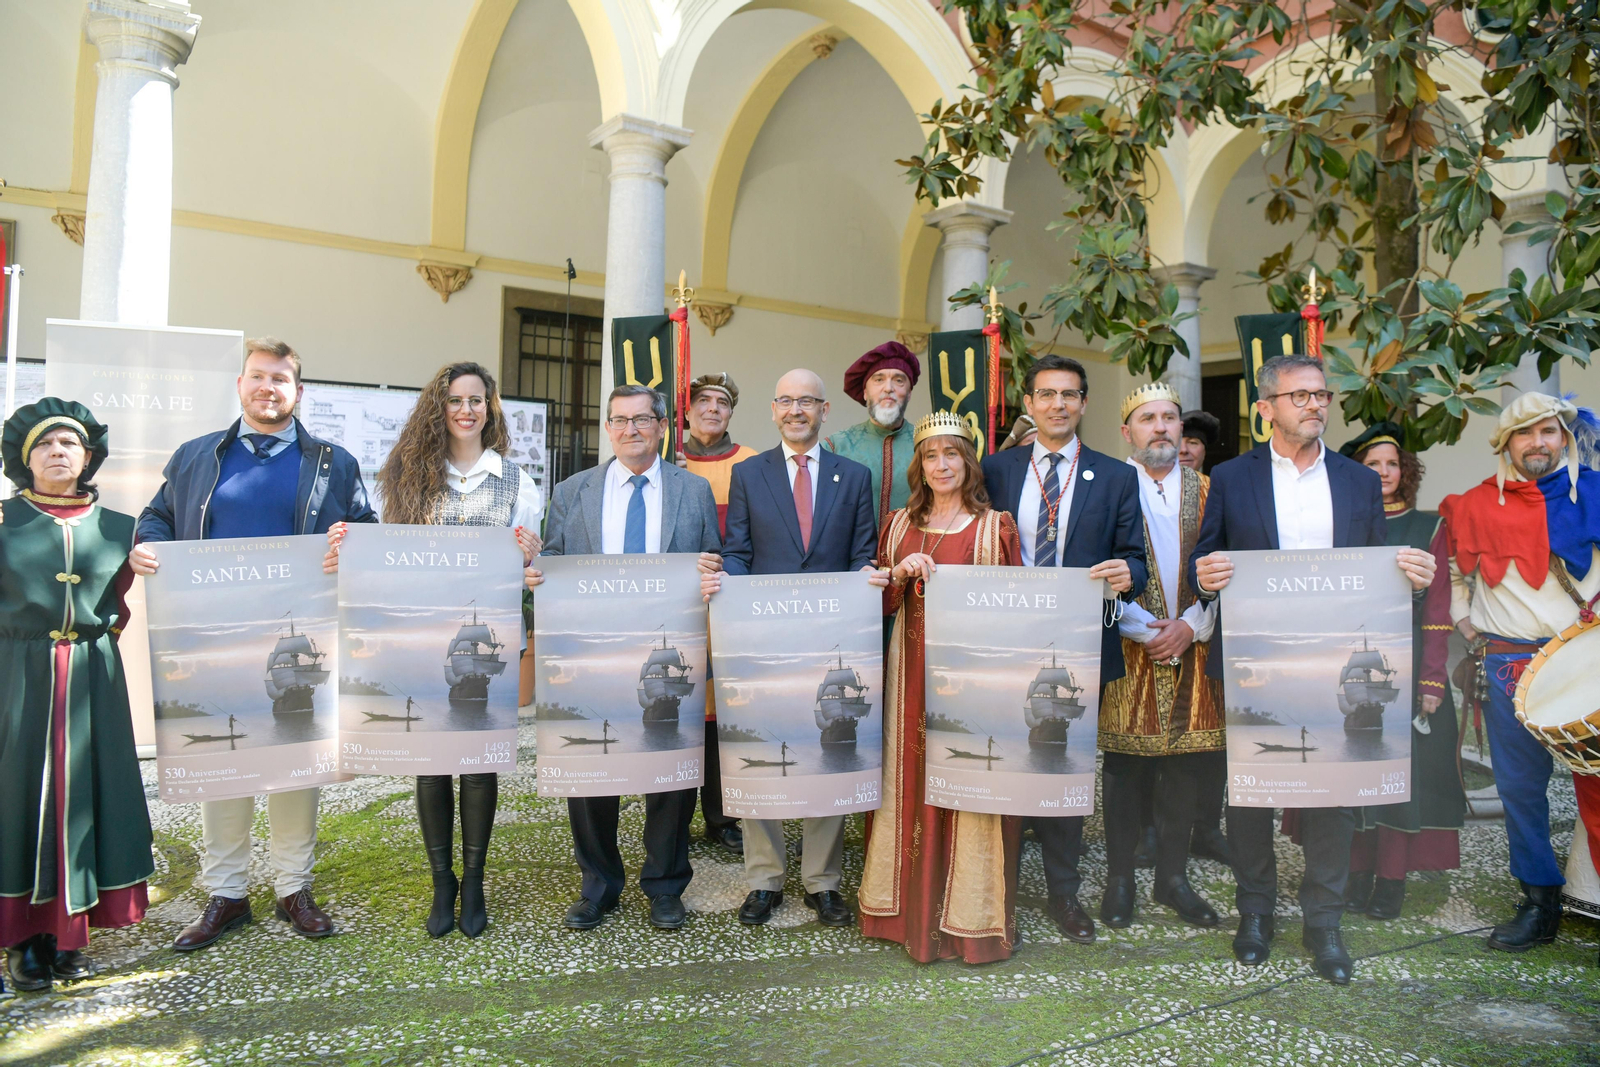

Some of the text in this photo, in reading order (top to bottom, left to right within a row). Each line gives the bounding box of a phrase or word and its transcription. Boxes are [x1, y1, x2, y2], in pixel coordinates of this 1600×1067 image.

[92, 370, 195, 382] CAPITULACIONES
[92, 392, 193, 411] SANTA FE
[385, 529, 480, 539] CAPITULACIONES
[189, 541, 290, 554] CAPITULACIONES
[385, 551, 479, 567] SANTA FE
[576, 558, 667, 566] CAPITULACIONES
[1265, 553, 1364, 563] CAPITULACIONES
[191, 563, 292, 584] SANTA FE
[966, 570, 1058, 580] CAPITULACIONES
[577, 578, 667, 594] SANTA FE
[750, 577, 840, 587] CAPITULACIONES
[1266, 575, 1365, 593] SANTA FE
[966, 591, 1058, 609] SANTA FE
[752, 598, 841, 616] SANTA FE
[342, 742, 410, 756] 530 Aniversario
[484, 741, 511, 753] 1492
[315, 750, 338, 763] 149
[459, 752, 510, 765] Abril 2022
[676, 759, 699, 771] 1492
[164, 767, 237, 779] 530 Aniversario
[290, 767, 312, 778] Abril
[541, 767, 608, 778] 530 Aniversario
[654, 769, 699, 784] Abril 2022
[1381, 771, 1405, 783] 1492
[855, 780, 877, 793] 1492
[928, 775, 991, 794] 530 Aniversario
[1233, 775, 1307, 787] 530 Aniversario
[725, 787, 742, 799] 530
[1063, 785, 1088, 797] 1492
[1357, 782, 1405, 797] Abril 2022
[833, 791, 878, 807] Abril 2022
[1038, 796, 1088, 808] Abril 2022
